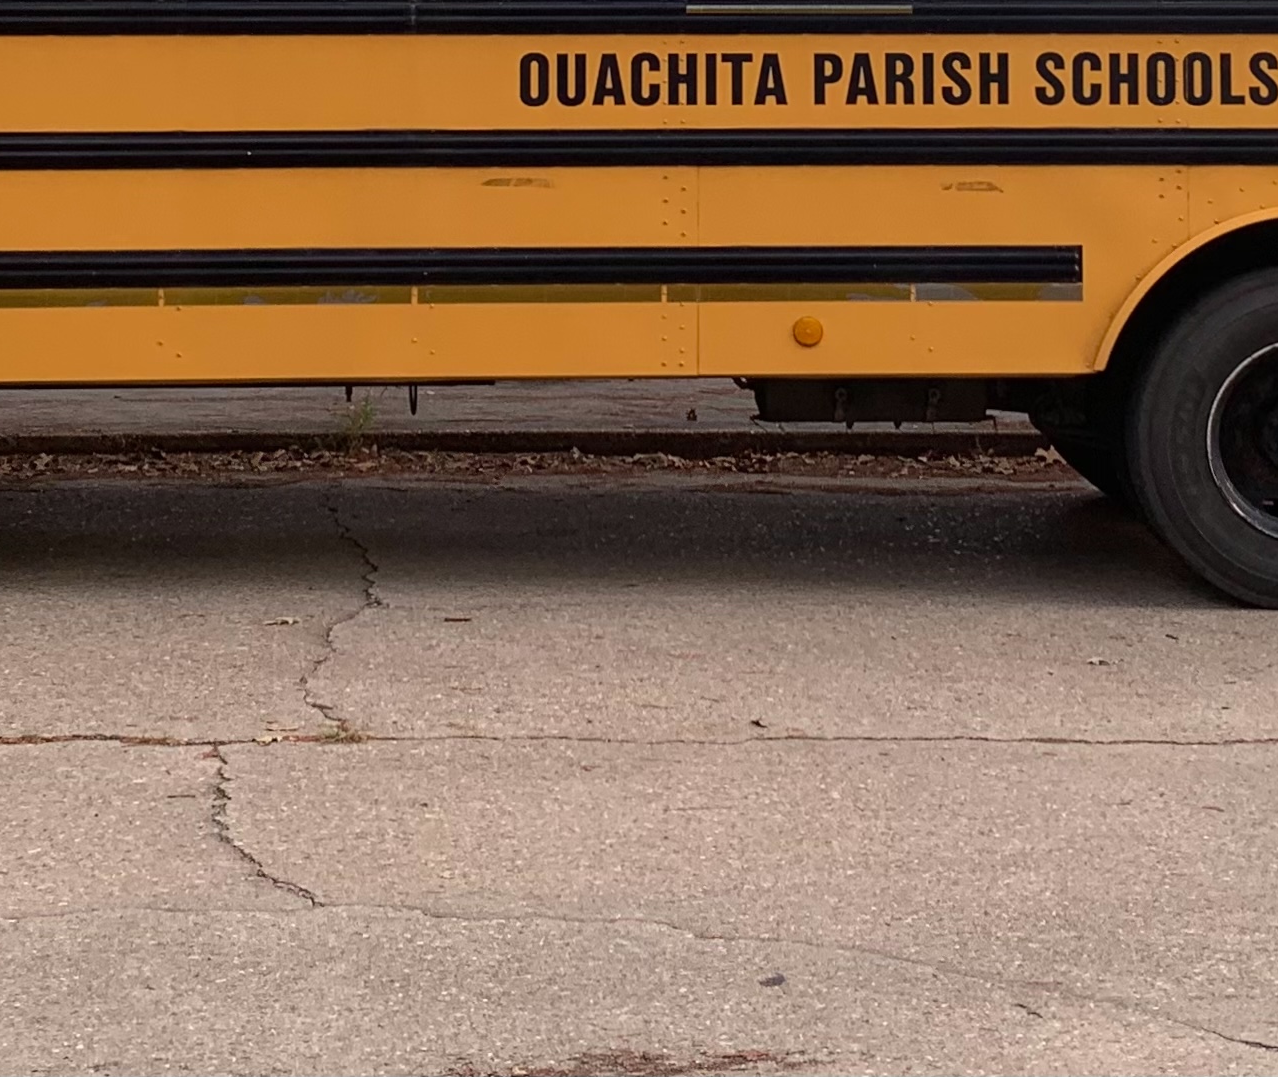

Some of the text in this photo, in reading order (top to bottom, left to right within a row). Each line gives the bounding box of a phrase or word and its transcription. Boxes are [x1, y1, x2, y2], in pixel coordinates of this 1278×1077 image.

[519, 51, 1278, 107] OUACHITA PARISH SCHOOLS
